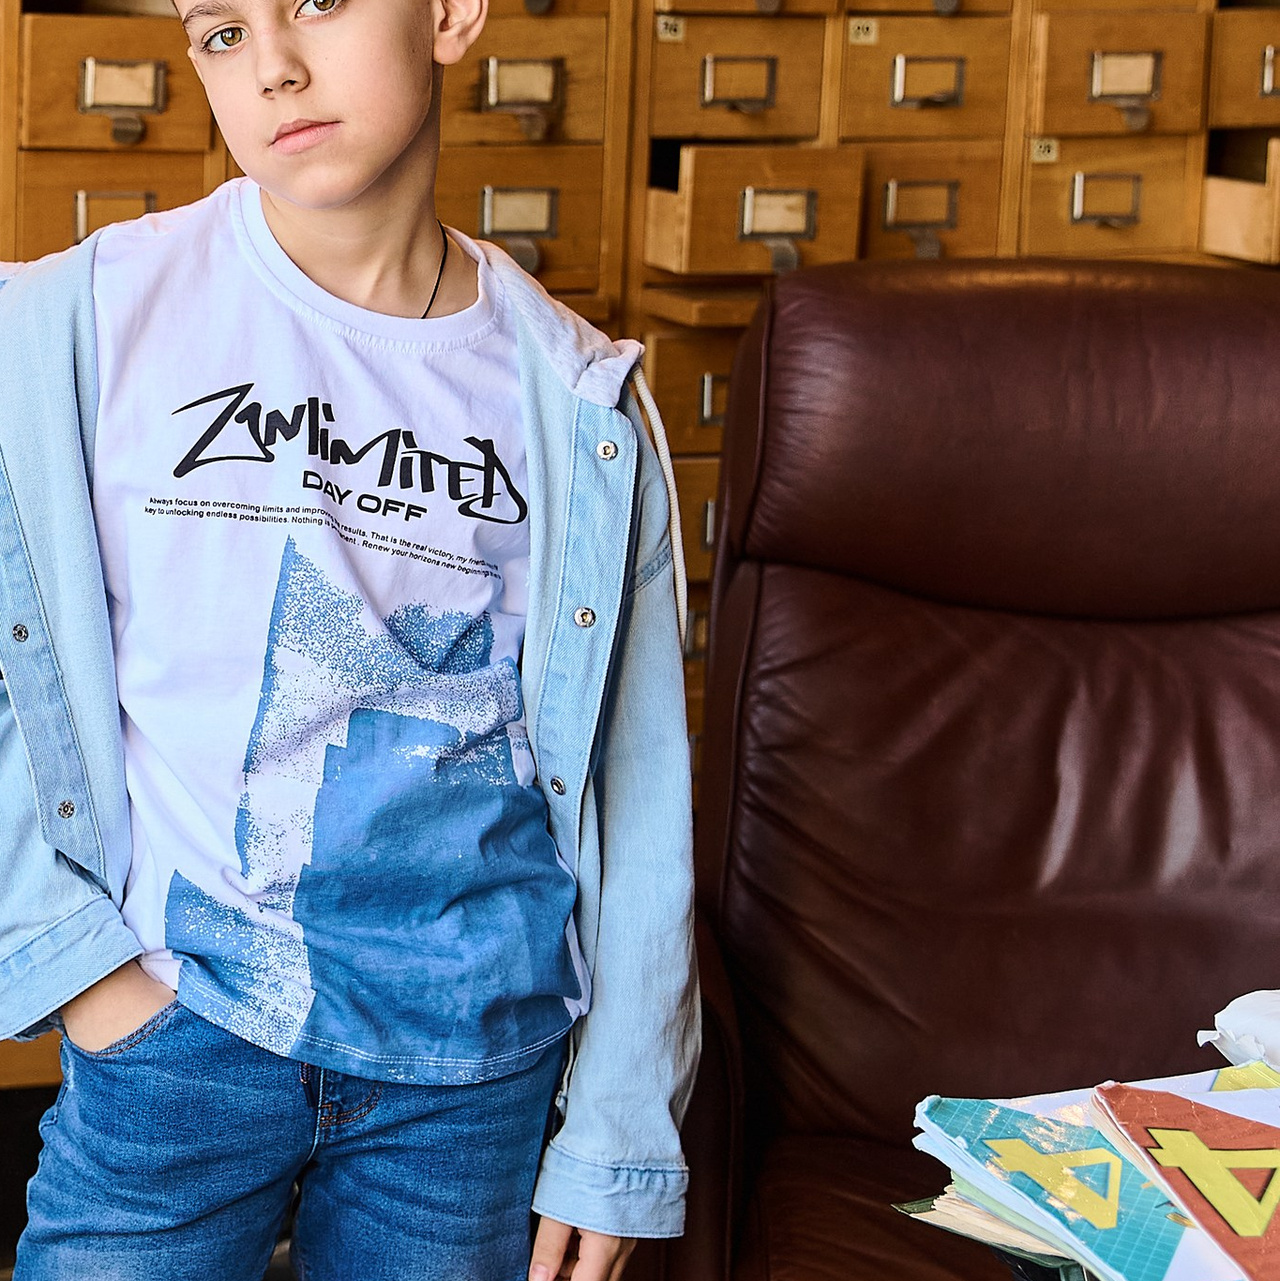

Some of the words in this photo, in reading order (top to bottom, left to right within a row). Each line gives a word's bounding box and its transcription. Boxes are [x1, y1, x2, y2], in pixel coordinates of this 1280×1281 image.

[302, 470, 353, 505] DAY
[356, 494, 428, 521] OFF
[144, 506, 157, 516] key
[165, 508, 204, 518] unlocking
[206, 510, 238, 519] endless
[291, 516, 323, 526] Nothing
[362, 540, 390, 552] Renew
[391, 548, 408, 558] your
[409, 551, 440, 566] horizons
[441, 561, 456, 570] new
[149, 497, 173, 507] Always
[175, 498, 198, 507] focus
[212, 500, 261, 514] overcoming
[262, 505, 284, 513] limits
[341, 524, 368, 538] results.
[371, 531, 389, 542] That
[390, 536, 397, 544] is
[399, 539, 411, 548] the
[412, 542, 428, 552] real
[428, 547, 455, 560] victory,
[456, 555, 468, 564] my
